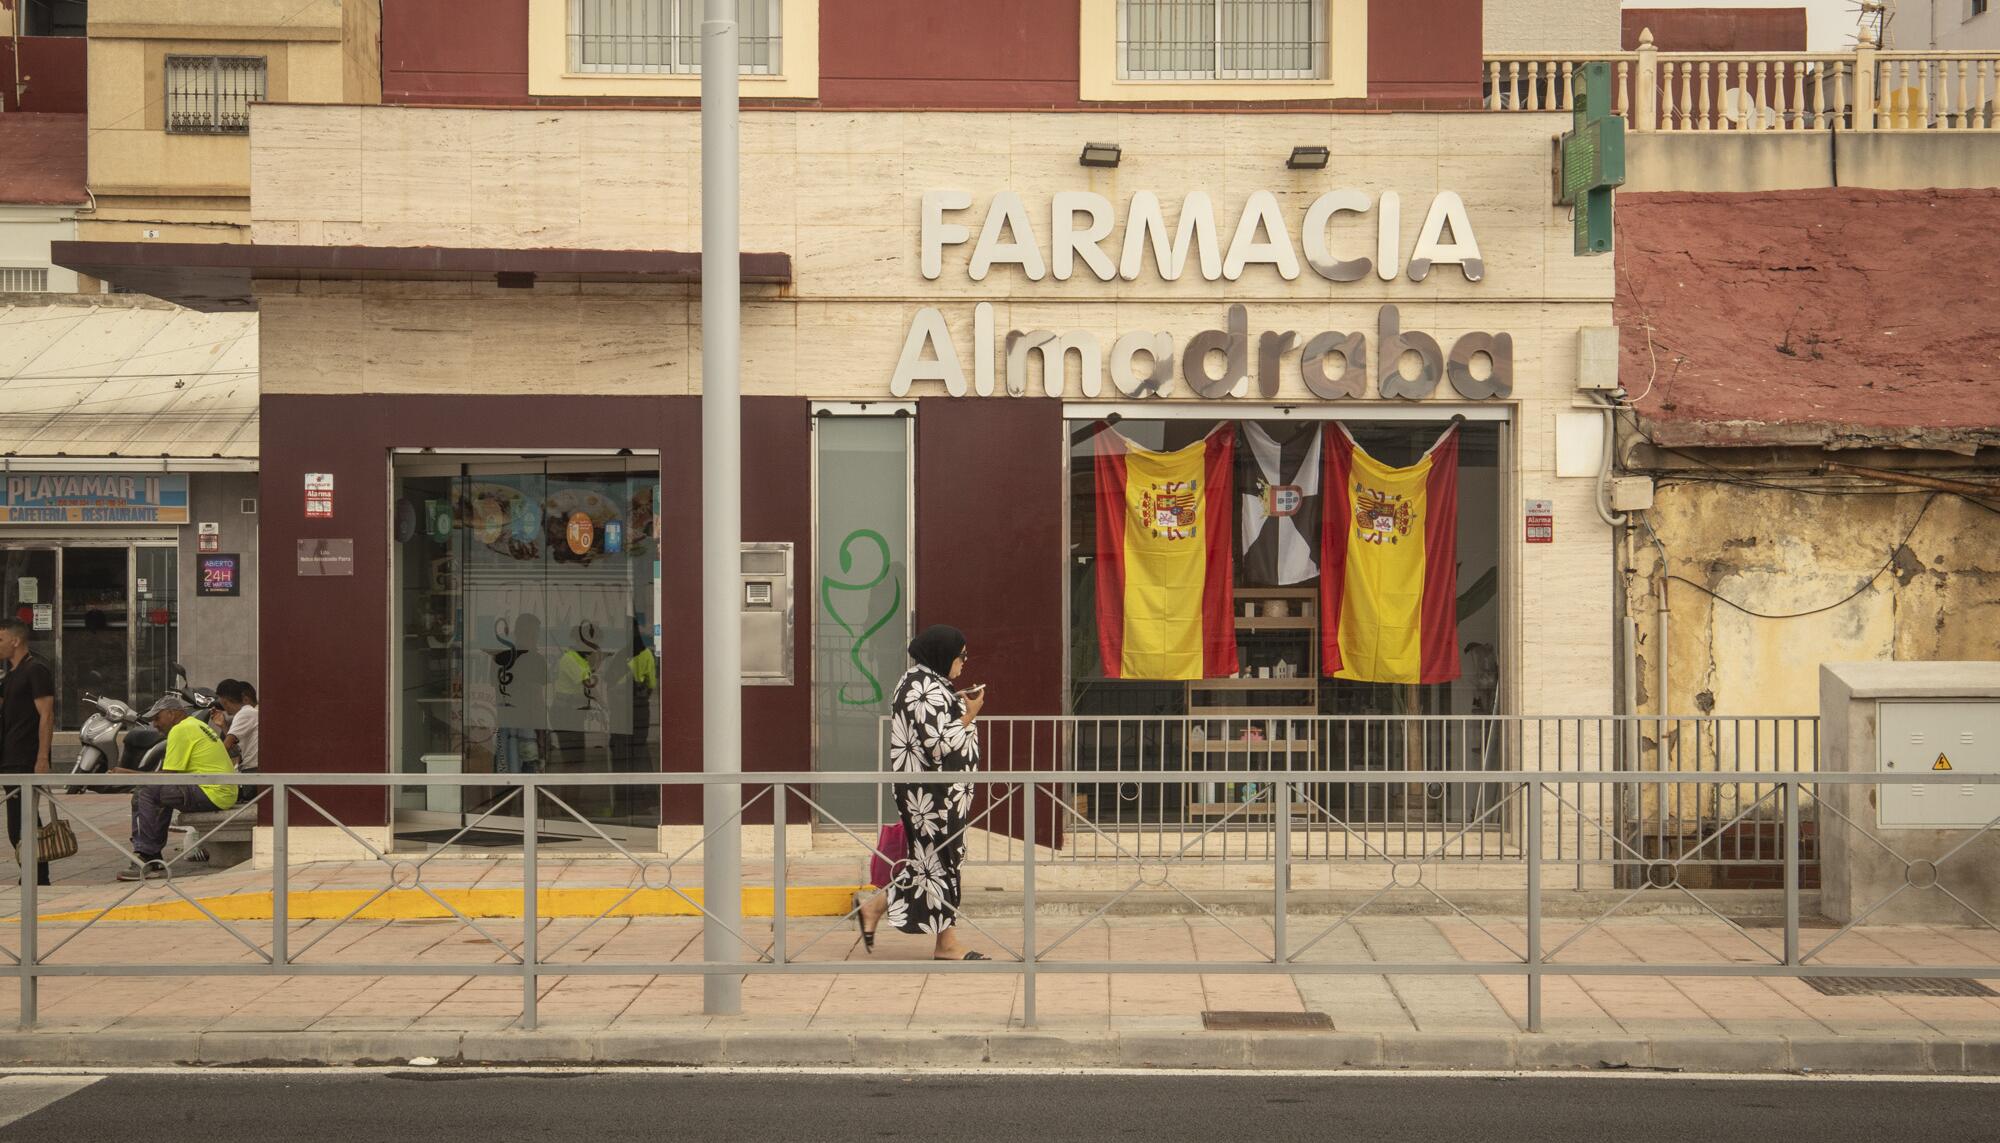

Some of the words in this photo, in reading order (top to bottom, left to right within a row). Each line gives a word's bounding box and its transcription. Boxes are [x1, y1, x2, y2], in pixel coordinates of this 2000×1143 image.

[920, 189, 1484, 282] FARMACIA
[890, 302, 1514, 400] Almadraba
[7, 476, 136, 506] PLAYAMAR
[145, 477, 161, 505] II
[81, 507, 159, 522] RESTAURANTE
[204, 569, 231, 582] 24H
